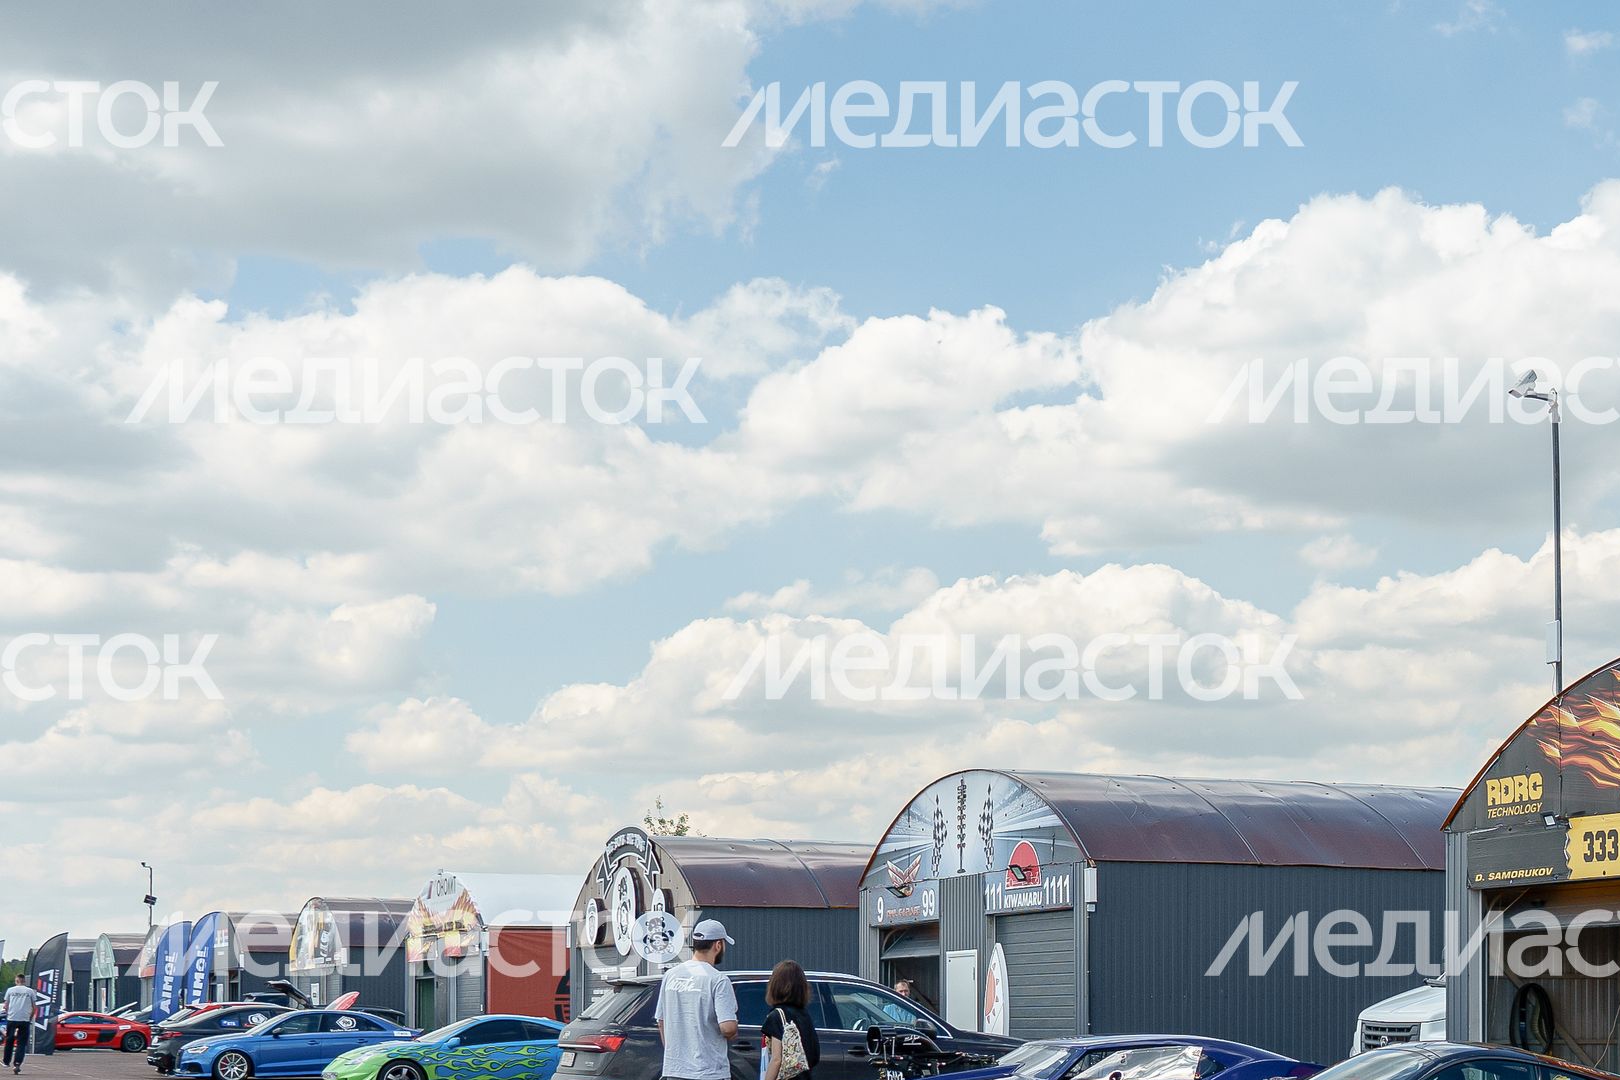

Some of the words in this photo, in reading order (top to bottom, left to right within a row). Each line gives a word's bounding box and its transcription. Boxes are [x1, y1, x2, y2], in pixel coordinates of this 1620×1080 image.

[1487, 802, 1543, 819] TECHNOLOGY
[1583, 829, 1619, 863] 333
[1475, 873, 1485, 882] D.
[1488, 867, 1554, 881] SAMORUKOV
[922, 890, 935, 918] 99
[985, 882, 1002, 911] 111
[1004, 891, 1043, 909] KIWAMARU
[1044, 874, 1070, 905] 1111
[877, 897, 884, 923] 9
[160, 951, 178, 1015] AIMOL
